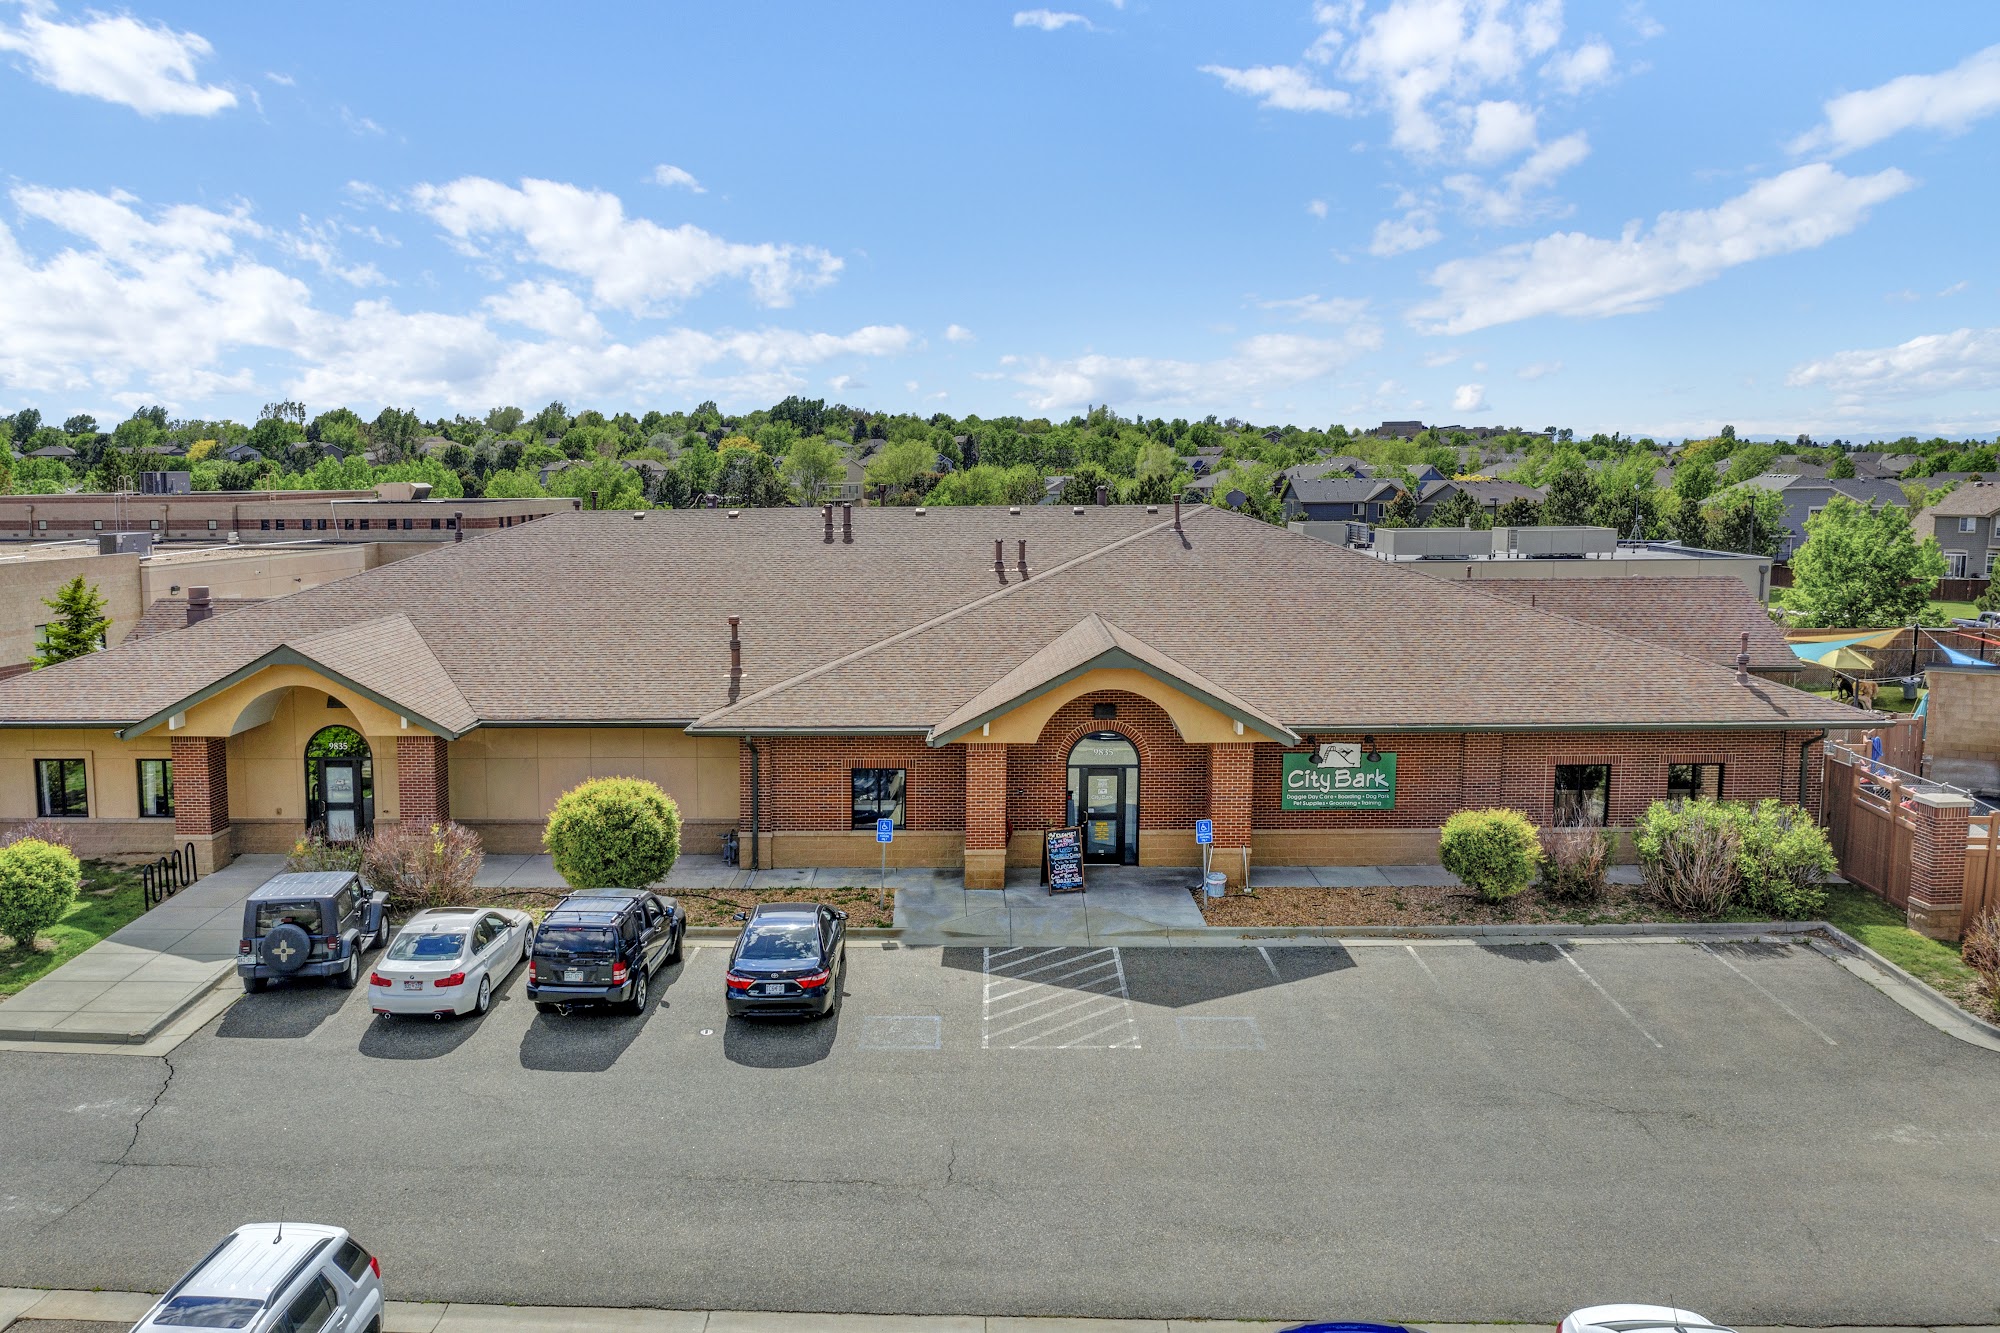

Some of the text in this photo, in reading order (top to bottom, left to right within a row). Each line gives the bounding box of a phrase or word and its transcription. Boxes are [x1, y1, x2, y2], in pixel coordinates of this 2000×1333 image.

[1093, 748, 1114, 756] 9835
[1288, 769, 1390, 792] City Bark
